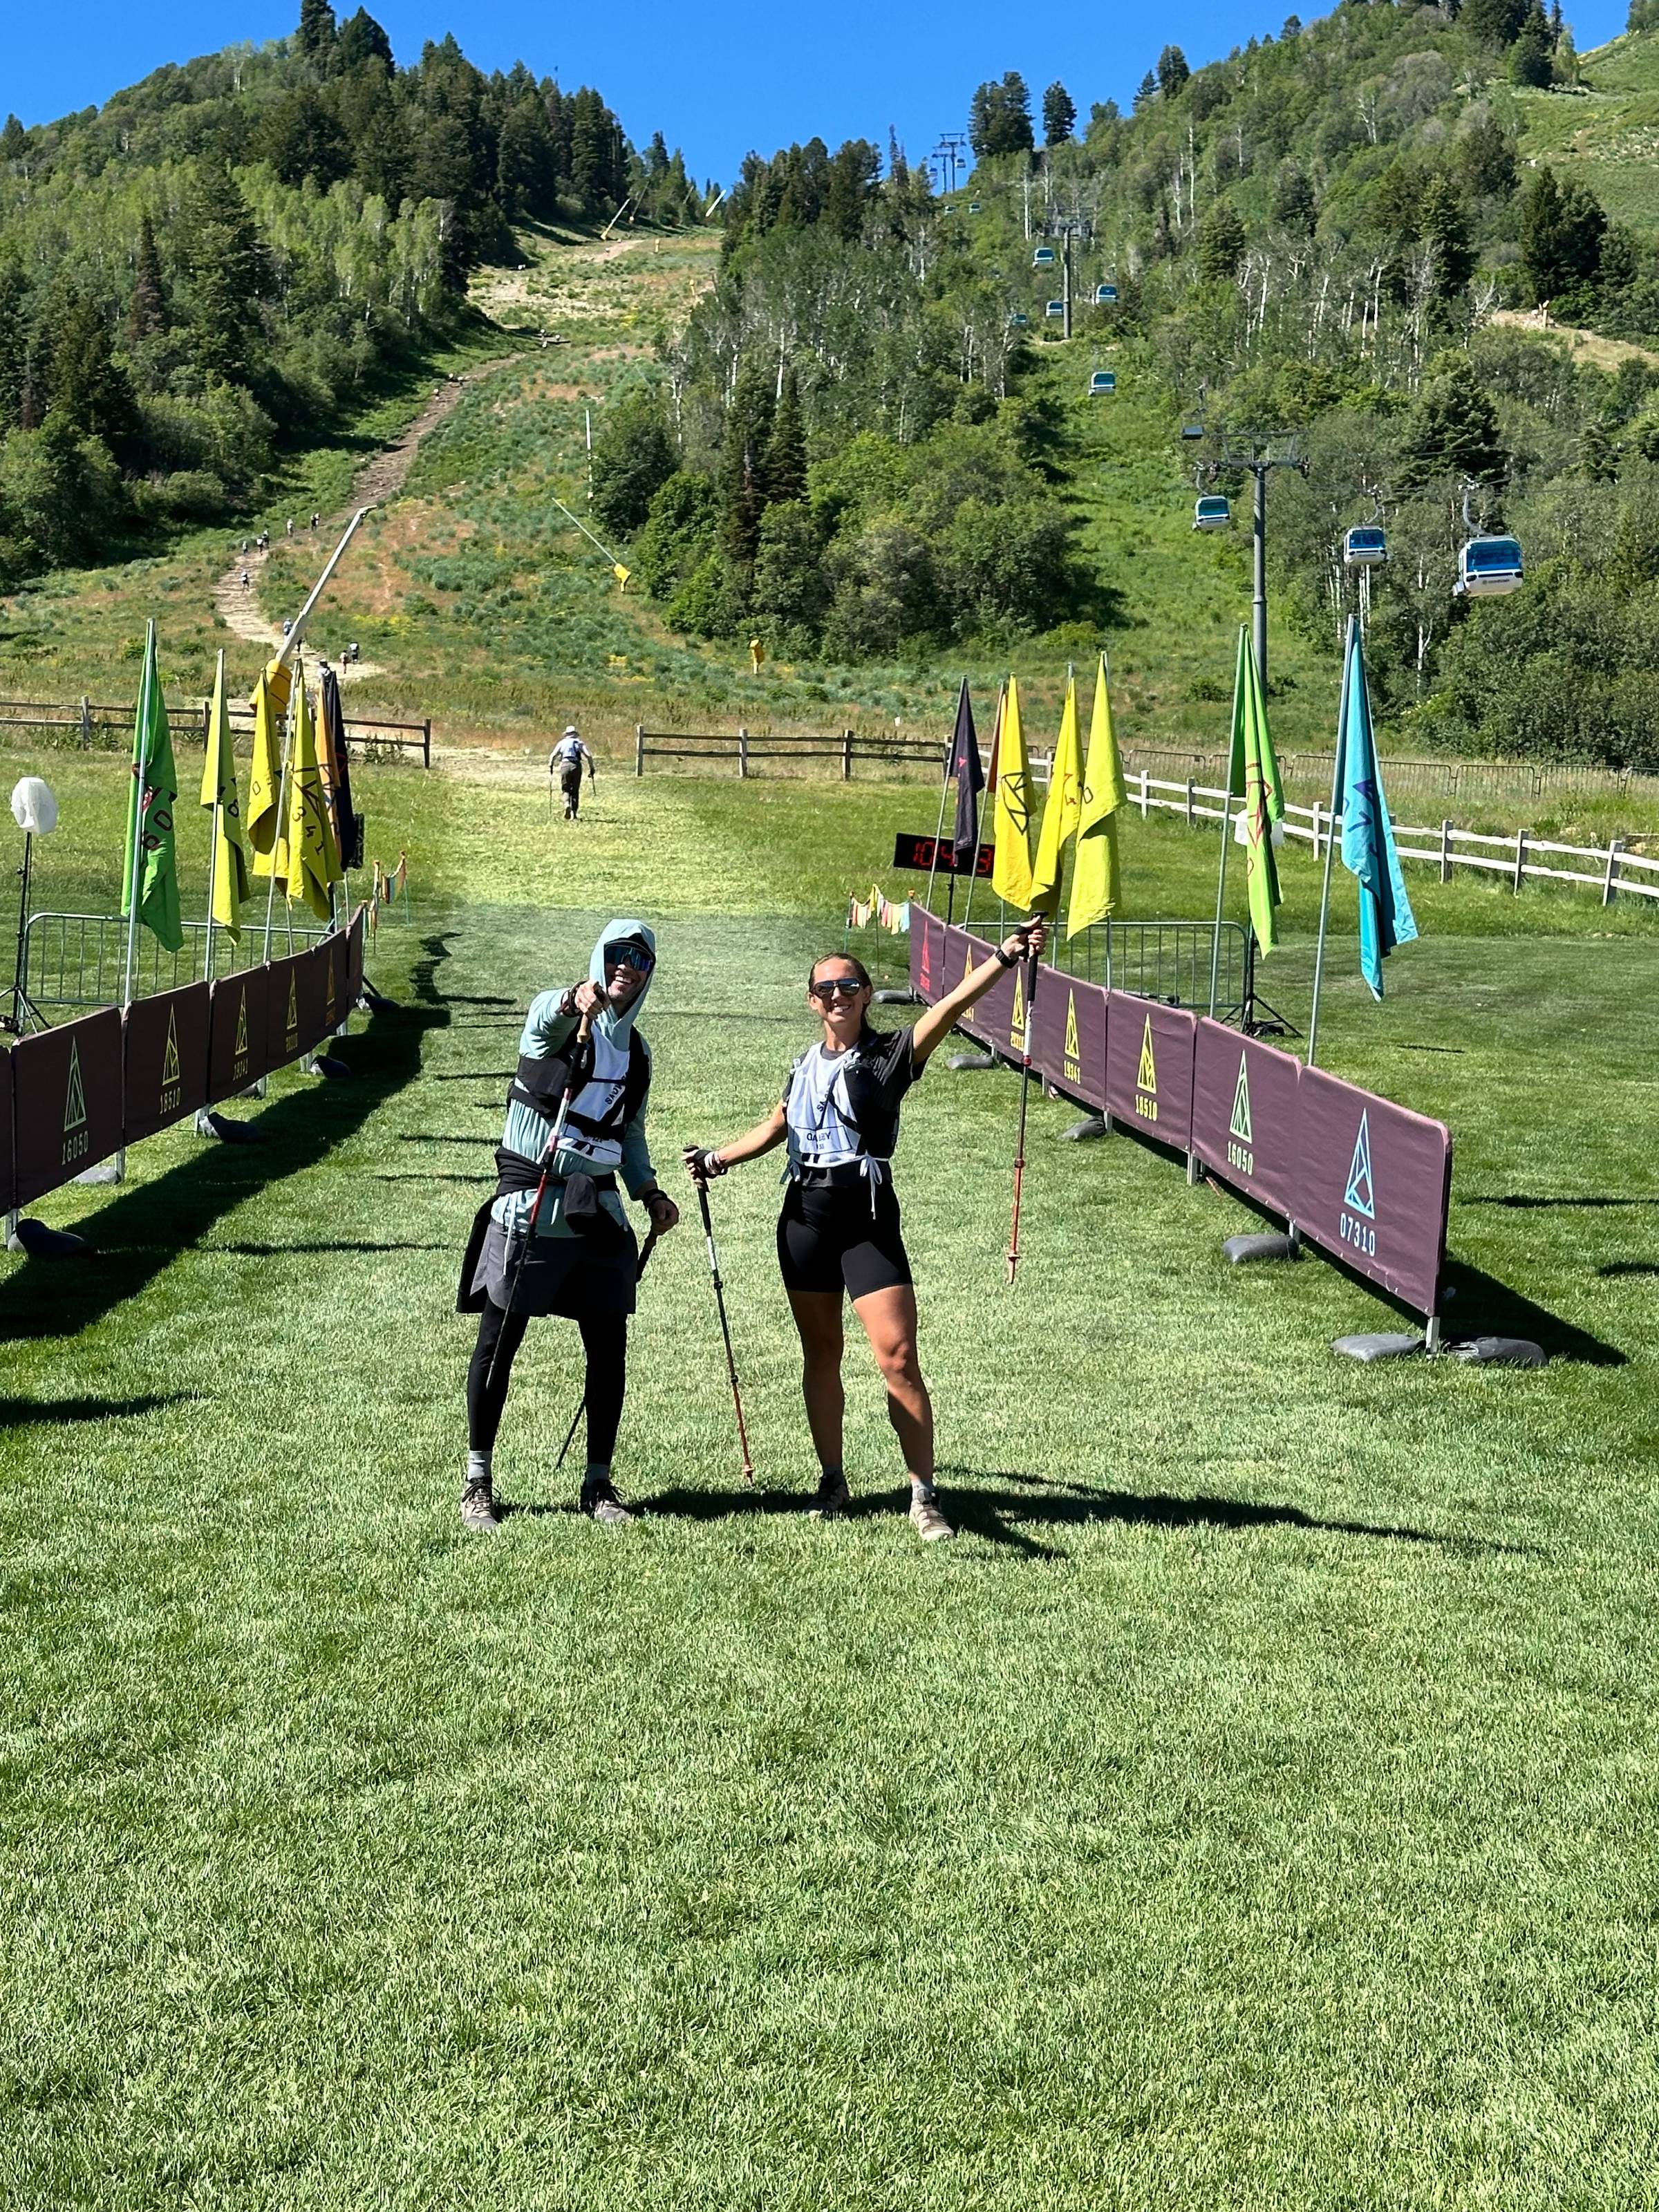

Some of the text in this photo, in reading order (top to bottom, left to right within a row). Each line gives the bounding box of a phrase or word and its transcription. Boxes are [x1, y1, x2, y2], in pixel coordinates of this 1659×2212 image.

[160, 1087, 181, 1114] 18510
[1135, 1094, 1158, 1121] 18510
[62, 1130, 89, 1166] 16050
[1227, 1141, 1253, 1176] 16050
[1340, 1212, 1376, 1257] 07310
